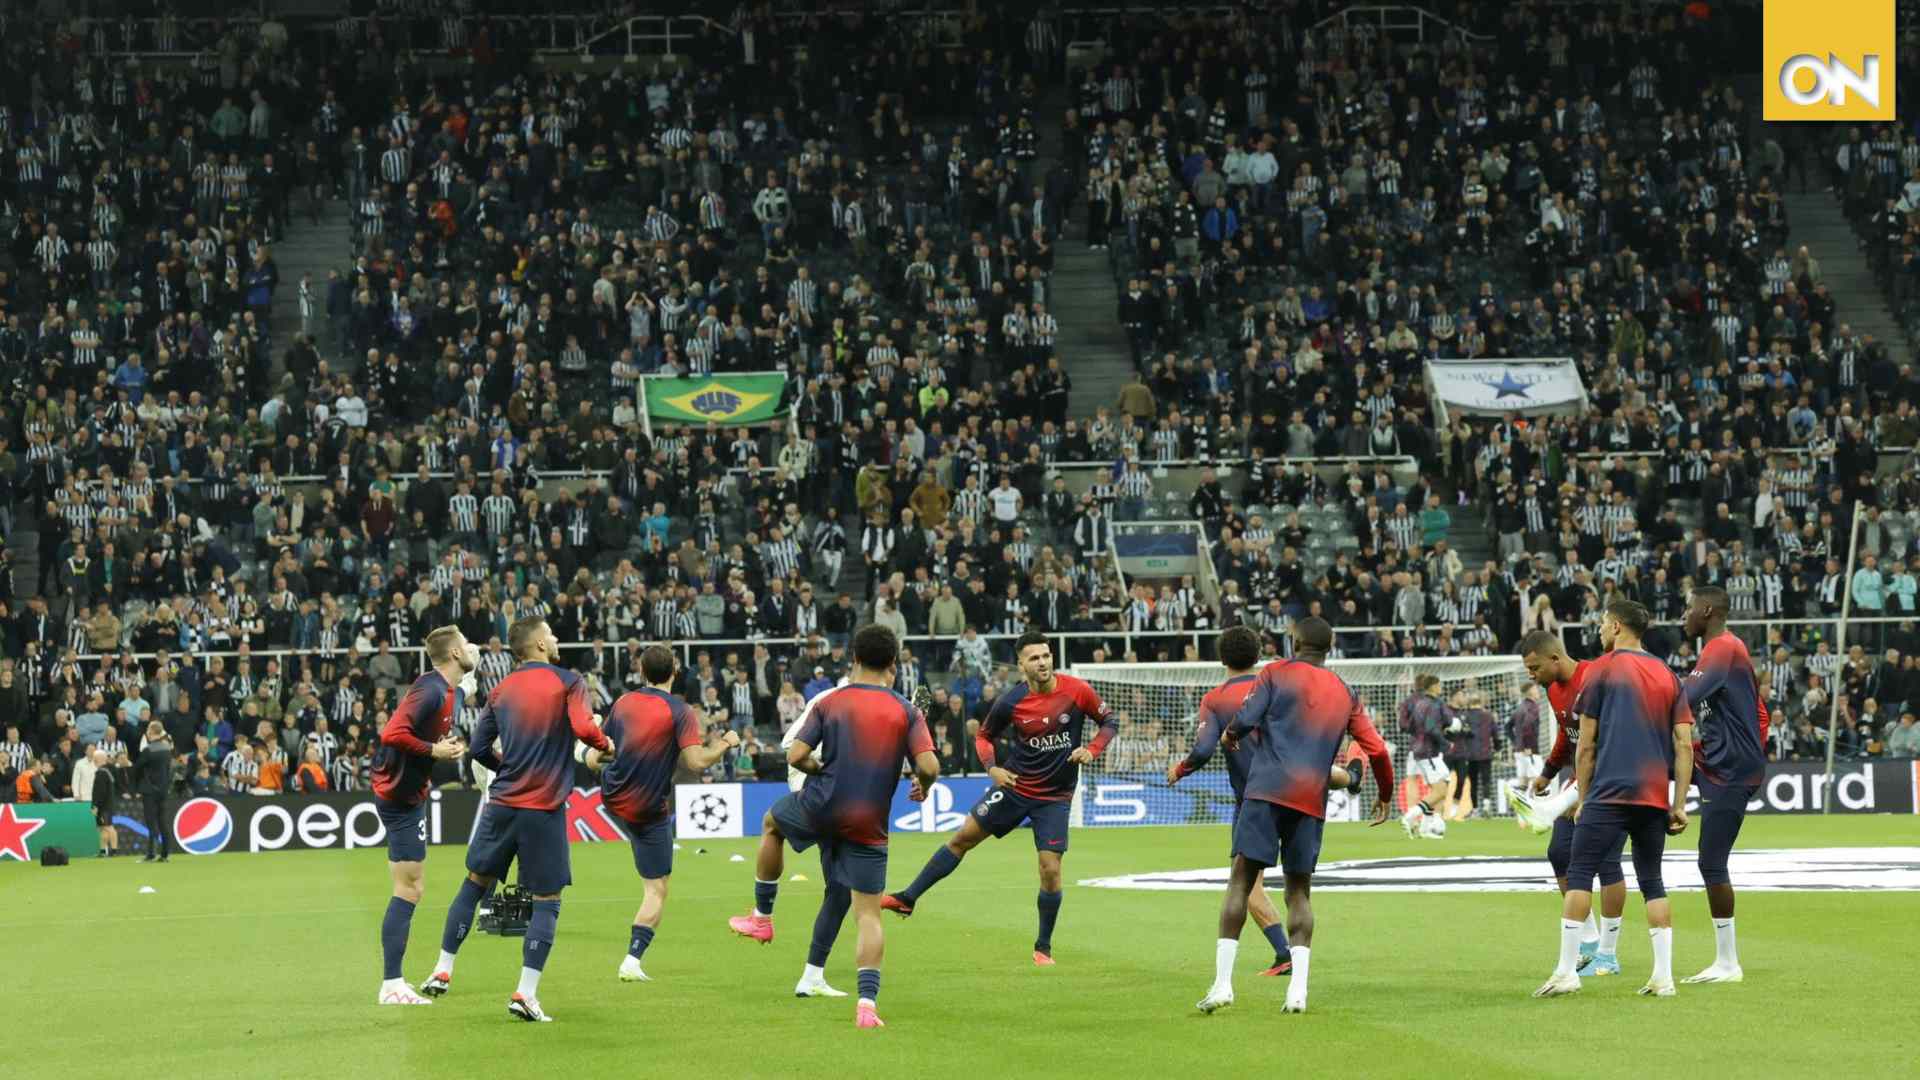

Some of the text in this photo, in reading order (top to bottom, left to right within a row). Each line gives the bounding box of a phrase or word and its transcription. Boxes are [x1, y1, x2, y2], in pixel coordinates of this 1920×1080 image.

[1447, 369, 1556, 384] NEWCSTLE
[1029, 731, 1070, 749] QATAR
[985, 791, 1004, 806] 9
[250, 790, 442, 853] pepi
